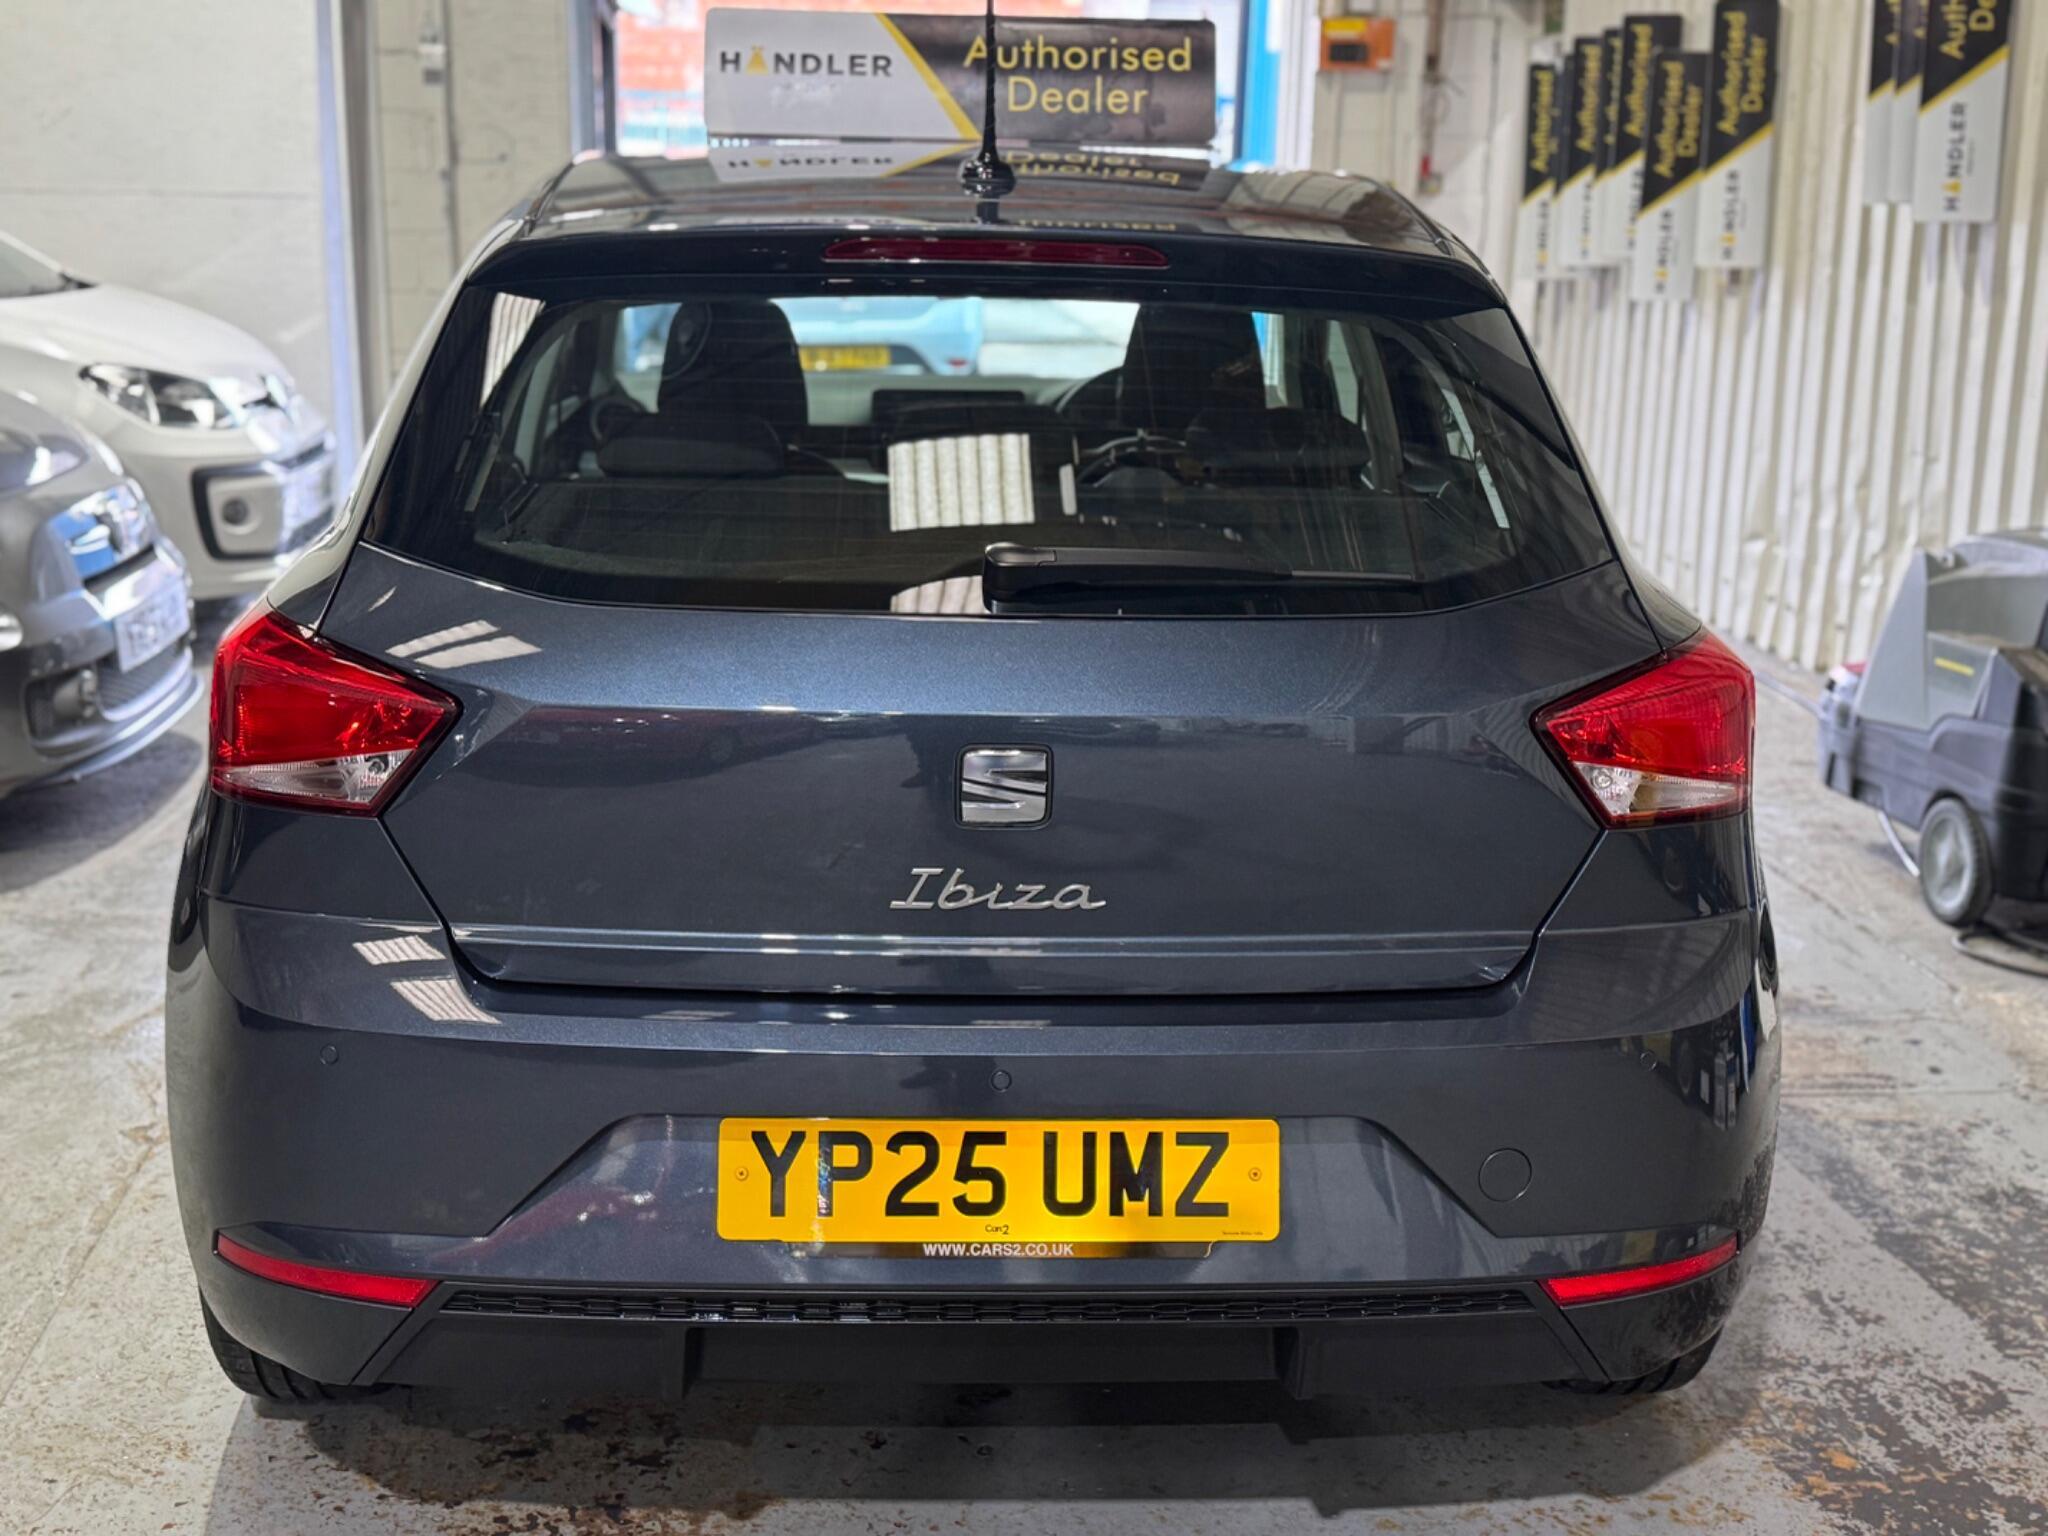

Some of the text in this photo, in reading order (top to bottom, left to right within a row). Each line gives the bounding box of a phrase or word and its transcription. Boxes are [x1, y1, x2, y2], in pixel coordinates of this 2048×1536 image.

[963, 34, 1192, 72] Authorised
[1716, 10, 1747, 136] Authorised
[1740, 34, 1768, 113] Dealer
[1008, 75, 1148, 114] Dealer
[889, 867, 1106, 909] Ibiza
[751, 1131, 1229, 1217] YP25 UMZ
[922, 1242, 1075, 1257] WWW.CARS2.CO.UK
